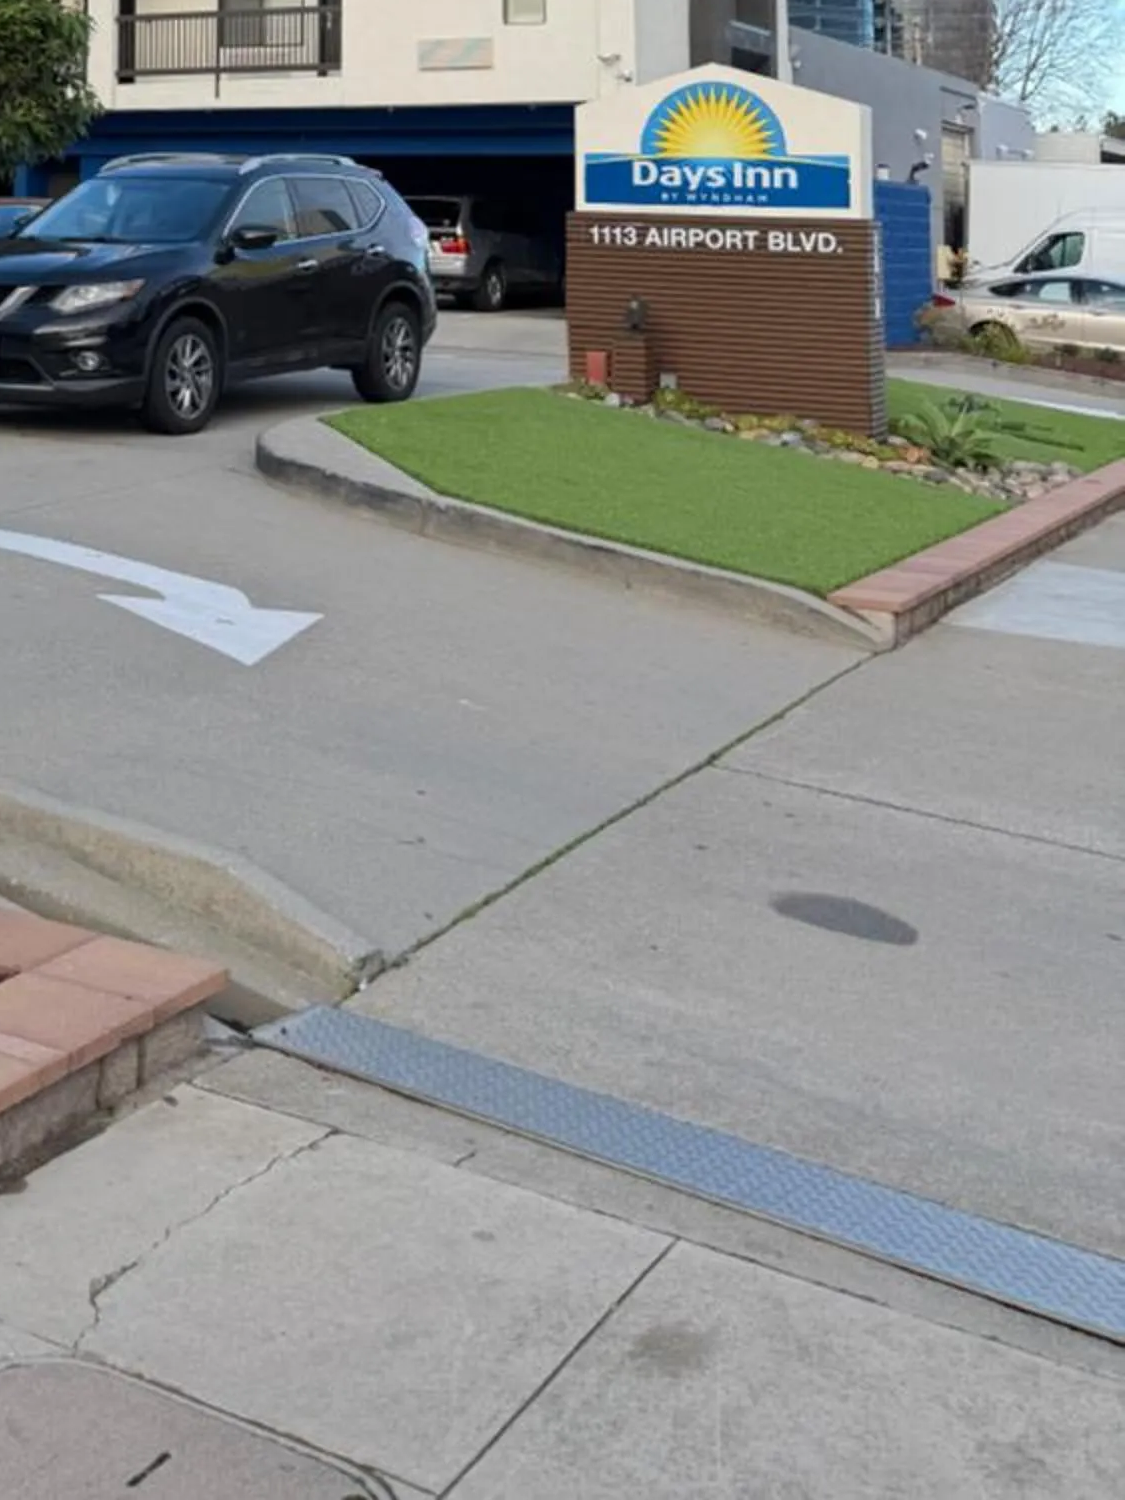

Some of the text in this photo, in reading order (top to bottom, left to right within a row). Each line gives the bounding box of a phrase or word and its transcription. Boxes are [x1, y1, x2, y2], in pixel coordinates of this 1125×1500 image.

[632, 160, 798, 191] Days Inn
[589, 227, 844, 254] 1113 AIRPORT BLVD.
